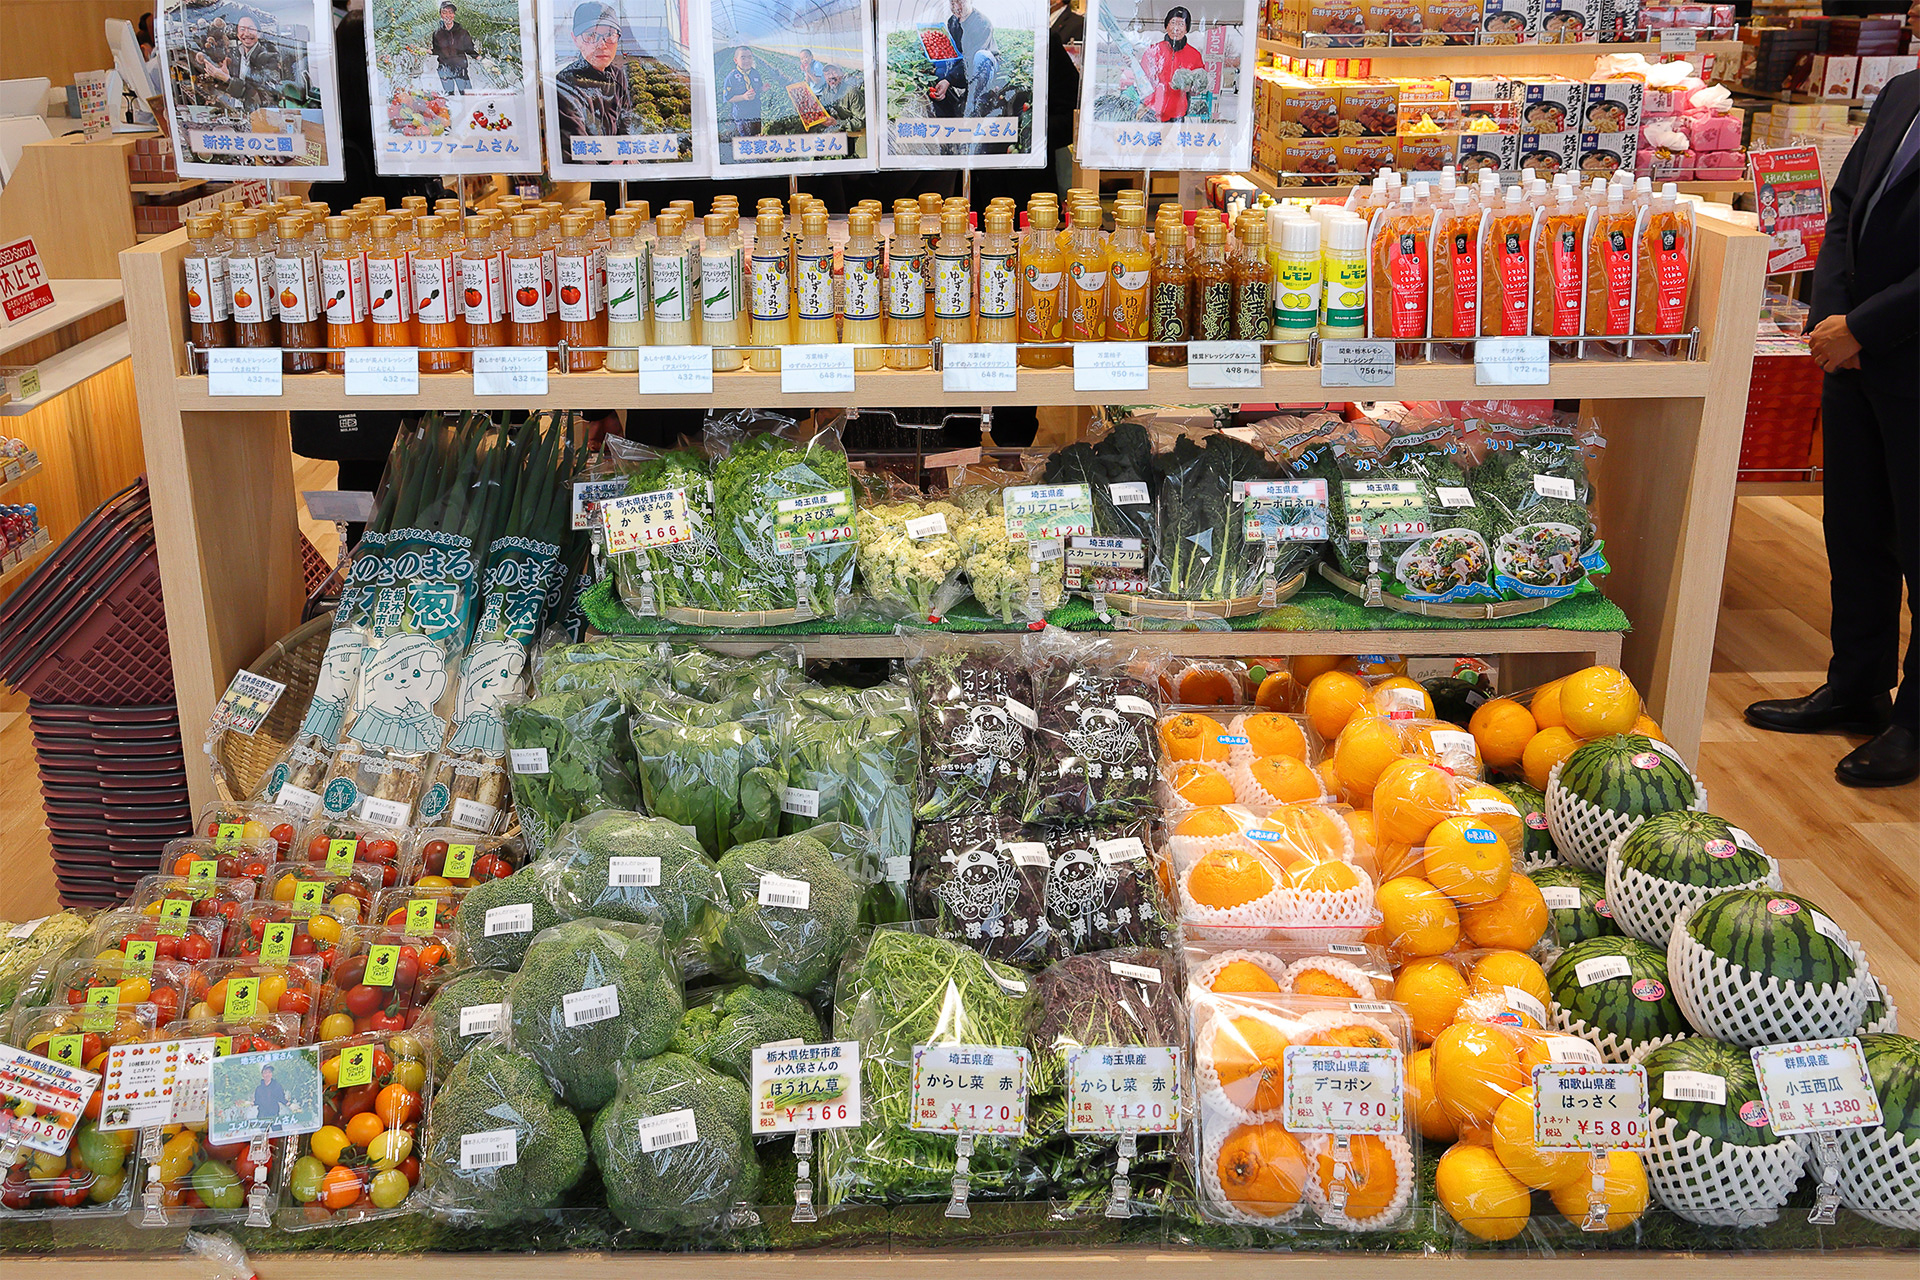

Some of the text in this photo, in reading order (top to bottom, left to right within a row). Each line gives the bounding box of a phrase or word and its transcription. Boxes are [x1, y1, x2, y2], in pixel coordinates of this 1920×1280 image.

[202, 133, 294, 153] 新井きのこ園
[385, 138, 520, 154] ユメリファームさん
[1116, 131, 1222, 147] 小久保 栄さん
[571, 138, 676, 156] 橋本 高志さん
[517, 271, 534, 279] とまと
[1282, 270, 1312, 281] レモン
[1661, 278, 1686, 286] ドレッシング
[765, 272, 780, 314] ゆずのみつ
[807, 271, 822, 314] ゆずのみつ
[853, 271, 869, 314] ゆずのみつ
[898, 270, 914, 313] ゆずのみつ
[949, 270, 965, 313] ゆずのみつ
[993, 270, 1010, 313] ゆずのみつ
[1396, 282, 1425, 290] ドレッシング
[478, 355, 543, 363] あしかが美人ドレッシング
[1093, 360, 1127, 368] ゆずのしずく
[1111, 370, 1127, 378] 950
[1514, 366, 1530, 374] 972
[1530, 453, 1558, 465] Kale
[1030, 489, 1065, 499] 埼玉県産
[1266, 485, 1299, 494] 埼玉県産
[1366, 484, 1400, 493] 埼玉県産
[615, 493, 675, 509] 栃木県佐野市産
[794, 495, 828, 508] 埼玉県産
[1360, 499, 1413, 508] ケール
[621, 501, 672, 516] 小久保さんの
[792, 508, 836, 523] わさび菜
[1016, 502, 1080, 515] カリフローレ
[620, 510, 675, 528] かき菜
[1011, 519, 1023, 527] 1袋
[1349, 515, 1362, 523] 1袋
[629, 526, 678, 543] ¥166
[778, 531, 791, 539] 1袋
[806, 527, 852, 543] ¥120
[1012, 531, 1025, 539] 税込
[1040, 524, 1086, 538] ¥120
[1276, 526, 1321, 538] ¥120
[1350, 528, 1363, 536] 税込
[1379, 522, 1425, 535] ¥120
[388, 527, 473, 548] 佐野市の未来を育む
[614, 538, 627, 546] 税込
[1088, 539, 1124, 549] 埼玉県産
[779, 542, 792, 550] 税込
[1067, 549, 1145, 561] スカーレットフリル
[374, 548, 474, 587] さのまる
[1068, 567, 1081, 575] 1袋
[1067, 579, 1081, 587] 税込
[1095, 579, 1143, 593] ¥120
[387, 587, 406, 628] 栃木県
[407, 580, 461, 630] 葱
[504, 587, 547, 637] 葱
[372, 587, 391, 640] 佐野市産
[485, 592, 504, 634] 栃木県
[1069, 900, 1157, 938] 深谷野菜
[240, 1051, 294, 1065] 地元の農家さん
[766, 1049, 842, 1065] 栃木県佐野市産
[948, 1053, 994, 1067] 埼玉県産
[1102, 1053, 1148, 1067] 埼玉県産
[1784, 1054, 1830, 1070] 群馬県産
[16, 1055, 73, 1079] 栃木県佐野市産
[773, 1061, 839, 1076] 小久保さんの
[1312, 1060, 1370, 1073] 和歌山県産
[2, 1064, 83, 1093] ユメリファームさんの
[926, 1074, 1014, 1091] からし菜 赤
[1080, 1076, 1167, 1093] からし菜 赤
[1313, 1077, 1373, 1092] デコポン
[1558, 1077, 1617, 1090] 和歌山県産
[769, 1078, 839, 1097] ほうれん草
[1785, 1076, 1844, 1097] 小玉西瓜
[0, 1081, 80, 1112] カラフルミニトマト
[920, 1097, 936, 1107] 1袋
[1297, 1096, 1314, 1105] 1袋
[1561, 1093, 1619, 1109] はっさく
[759, 1101, 775, 1111] 1袋
[951, 1102, 1011, 1120] ¥120
[1076, 1102, 1093, 1112] 1袋
[1103, 1102, 1163, 1119] ¥120
[1321, 1101, 1387, 1118] ¥780
[1778, 1100, 1791, 1110] 1個
[1803, 1098, 1862, 1118] ¥1,380
[785, 1103, 847, 1122] ¥166
[920, 1109, 938, 1119] 税込
[1077, 1113, 1094, 1124] 税込
[1296, 1108, 1315, 1118] 税込
[1779, 1111, 1796, 1122] 税込
[228, 1114, 299, 1132] ユメリファームさん
[759, 1117, 776, 1127] 税込
[1542, 1116, 1571, 1125] 1ネット
[1545, 1128, 1562, 1138] 税込
[1577, 1120, 1638, 1136] ¥580
